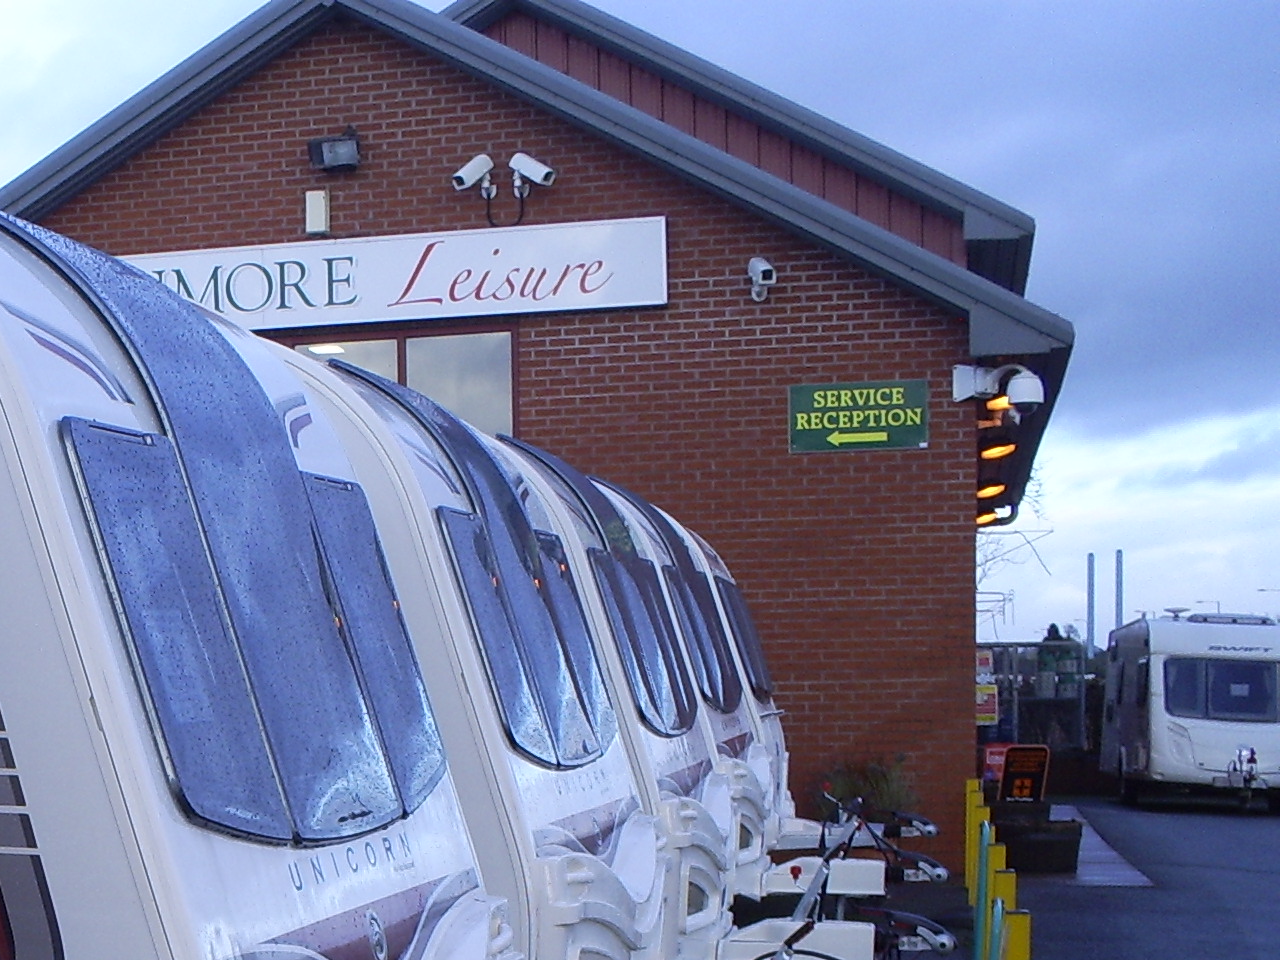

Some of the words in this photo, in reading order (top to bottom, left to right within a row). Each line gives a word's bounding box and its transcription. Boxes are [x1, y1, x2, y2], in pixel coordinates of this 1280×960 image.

[151, 255, 360, 314] MORE
[386, 240, 616, 309] Leisure
[813, 387, 905, 408] SERVICE
[795, 408, 923, 430] RECEPTION
[287, 832, 412, 891] UNICORN
